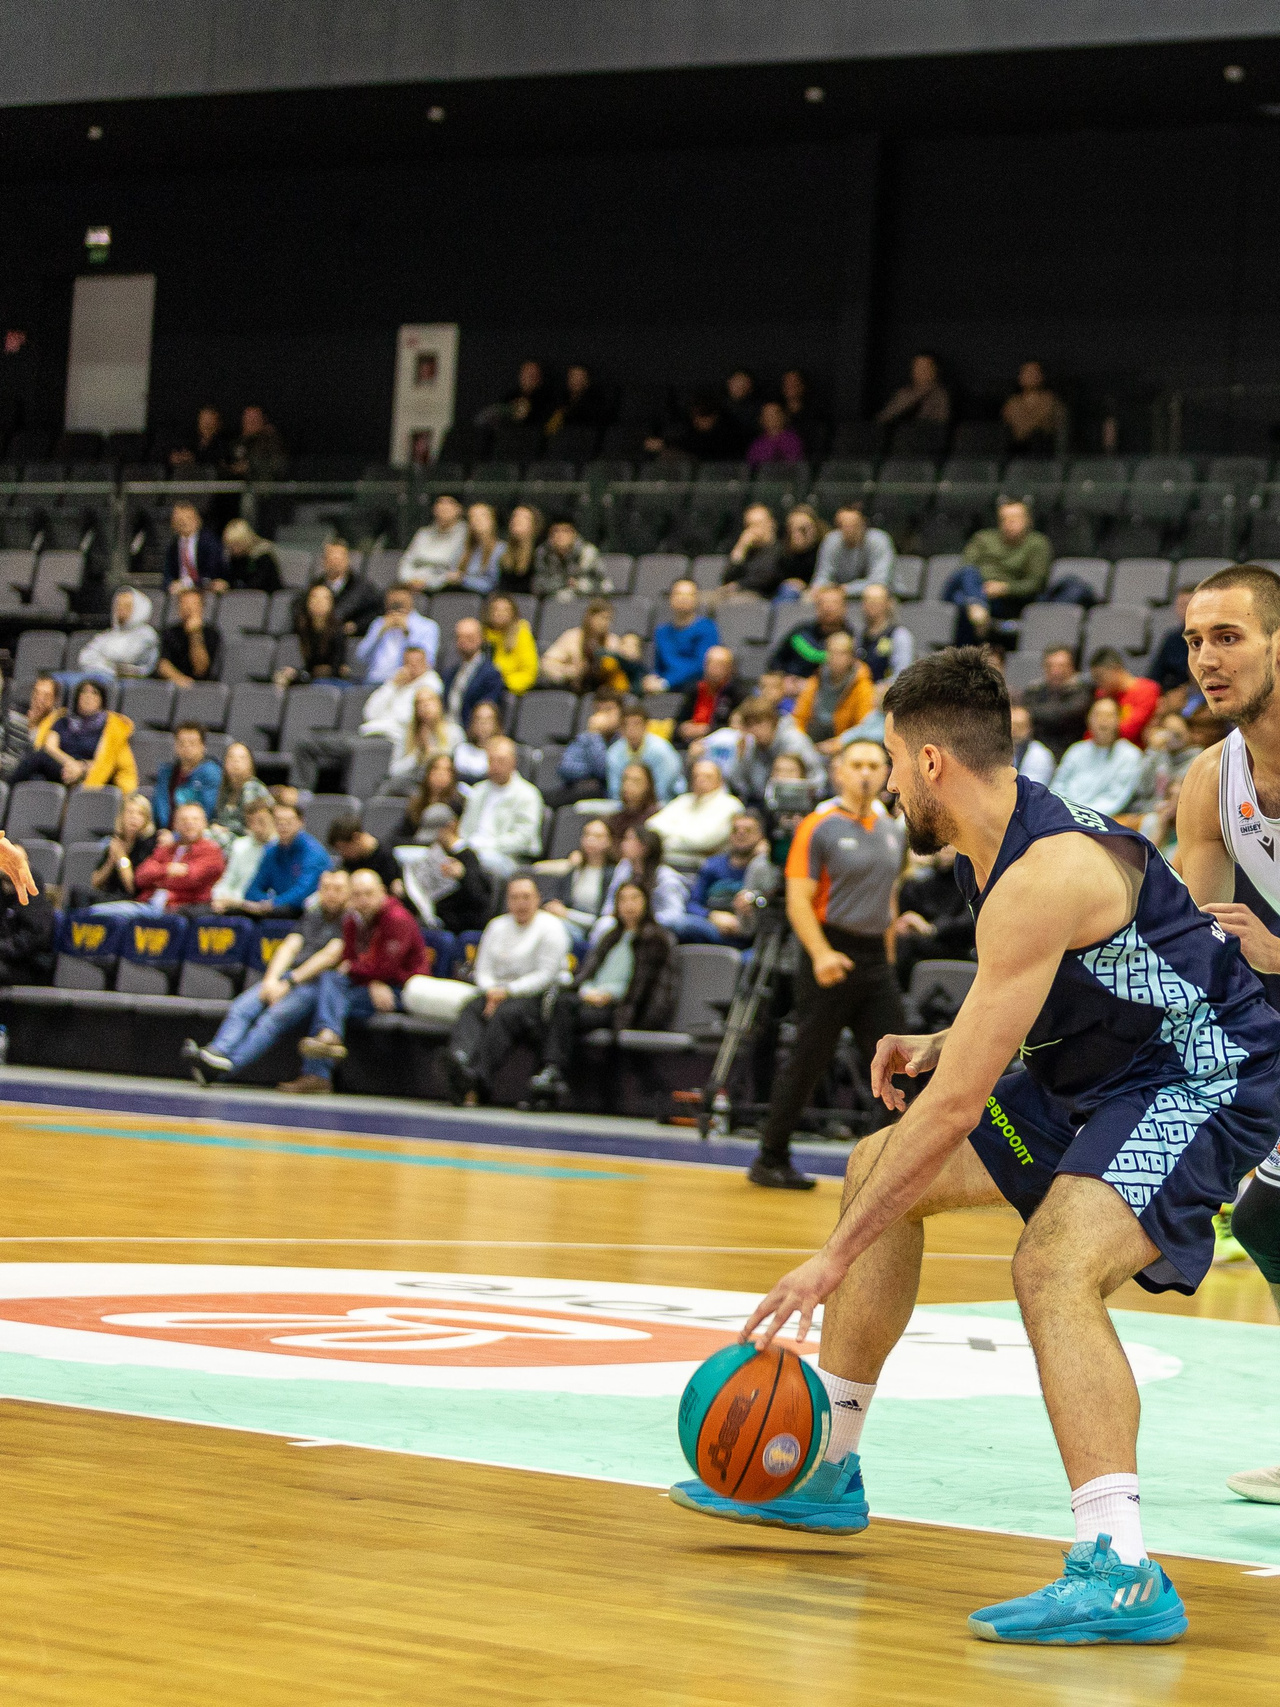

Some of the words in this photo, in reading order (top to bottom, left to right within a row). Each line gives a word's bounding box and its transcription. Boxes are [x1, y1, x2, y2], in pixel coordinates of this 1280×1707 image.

[72, 921, 107, 951] VIP
[134, 925, 170, 957] VIP
[198, 926, 236, 955] VIP
